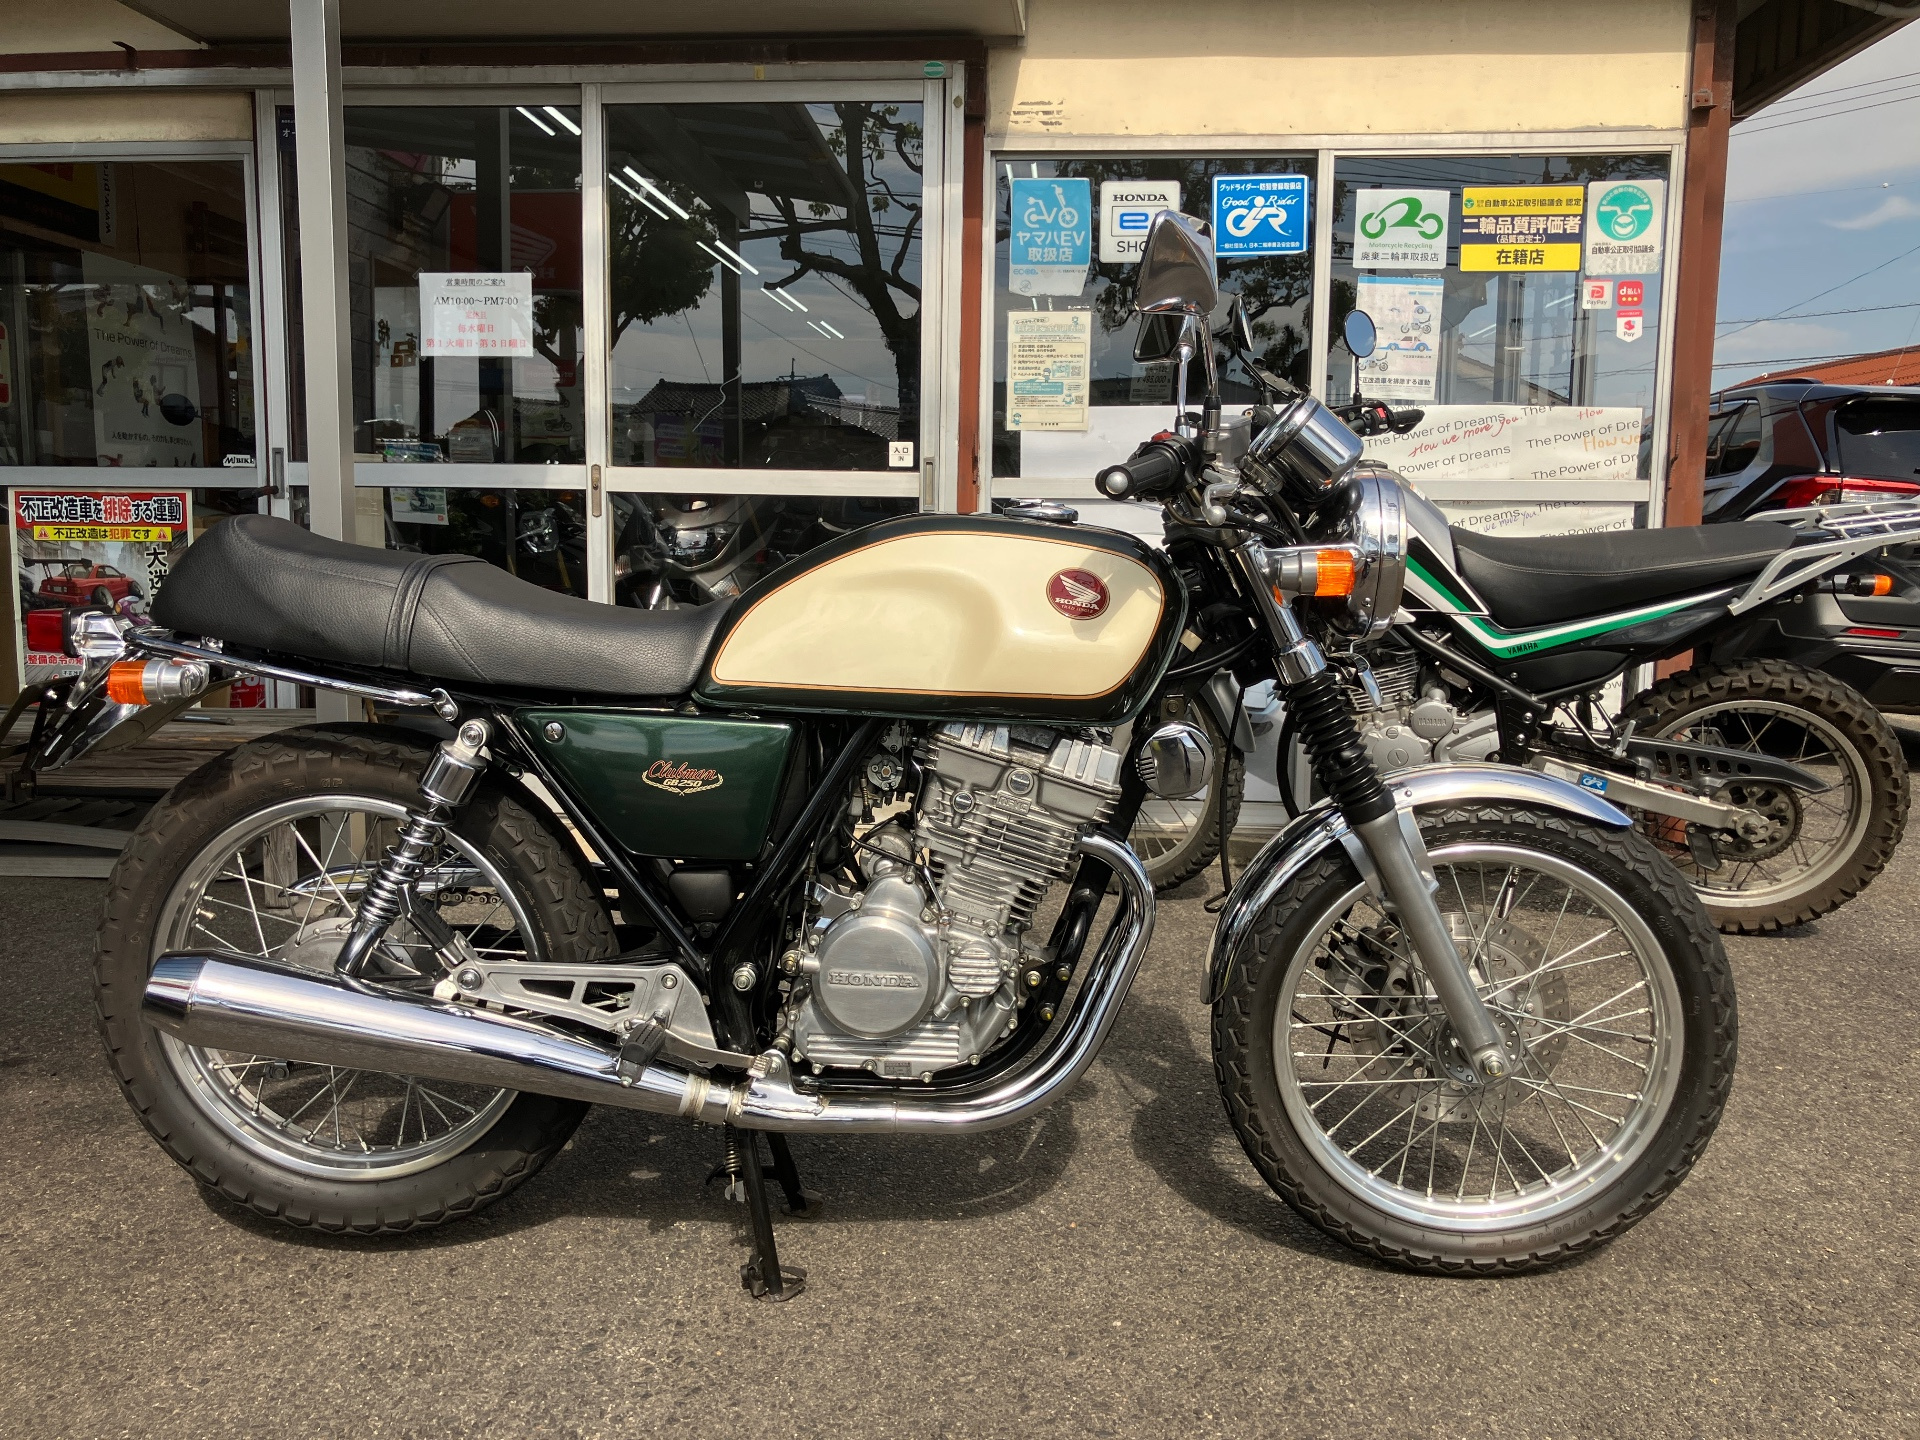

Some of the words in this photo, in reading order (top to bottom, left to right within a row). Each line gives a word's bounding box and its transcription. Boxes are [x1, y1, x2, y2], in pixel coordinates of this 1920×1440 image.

[1112, 194, 1169, 202] HONDA
[1222, 196, 1256, 209] Good
[1265, 195, 1300, 212] Rider
[1485, 199, 1563, 208] 自動車公正取引協議会
[1566, 198, 1581, 206] 認定
[1462, 216, 1581, 235] 二輪品質評価者
[1016, 231, 1086, 247] ヤマハEV
[1404, 242, 1433, 250] Recycling
[1028, 247, 1073, 262] 取扱店
[1361, 252, 1440, 262] 廃棄二輪車取扱店
[1496, 248, 1545, 265] 在籍店
[1591, 245, 1655, 255] 自動車公正取引協議会
[446, 278, 506, 287] 営業時間のご案内
[1619, 286, 1641, 295] d払い
[465, 310, 487, 319] 定休日
[458, 323, 494, 333] 毎水曜日
[94, 328, 115, 343] The
[117, 332, 148, 348] Power
[149, 340, 159, 351] of
[161, 341, 192, 358] Dreams
[1520, 406, 1546, 417] The
[1577, 408, 1604, 420] How
[1365, 437, 1391, 448] The
[1392, 427, 1434, 443] Power
[1437, 423, 1450, 434] of
[1453, 413, 1505, 431] Dreams
[1525, 438, 1552, 449] The
[1553, 427, 1596, 444] Power
[1598, 423, 1612, 435] of
[1408, 442, 1438, 458] How
[1442, 435, 1460, 446] we
[1463, 423, 1493, 440] move
[1583, 436, 1618, 452] How
[1621, 434, 1640, 445] we
[1398, 459, 1440, 474] Power
[1442, 455, 1456, 466] of
[1459, 445, 1511, 463] Dreams
[1531, 469, 1557, 480] The
[1559, 460, 1601, 476] Power
[1603, 456, 1618, 467] of
[20, 495, 182, 524] 不正改造車を排除する運動
[1468, 509, 1520, 526] Dreams
[1613, 519, 1628, 530] of
[53, 528, 152, 540] 不正改造は犯罪です
[1054, 597, 1100, 611] HONDA
[1506, 642, 1539, 656] YAMAHA
[1418, 717, 1447, 727] YAMAHA
[647, 760, 717, 781] Clubman
[662, 778, 703, 787] GB250
[828, 971, 920, 988] HONDA
